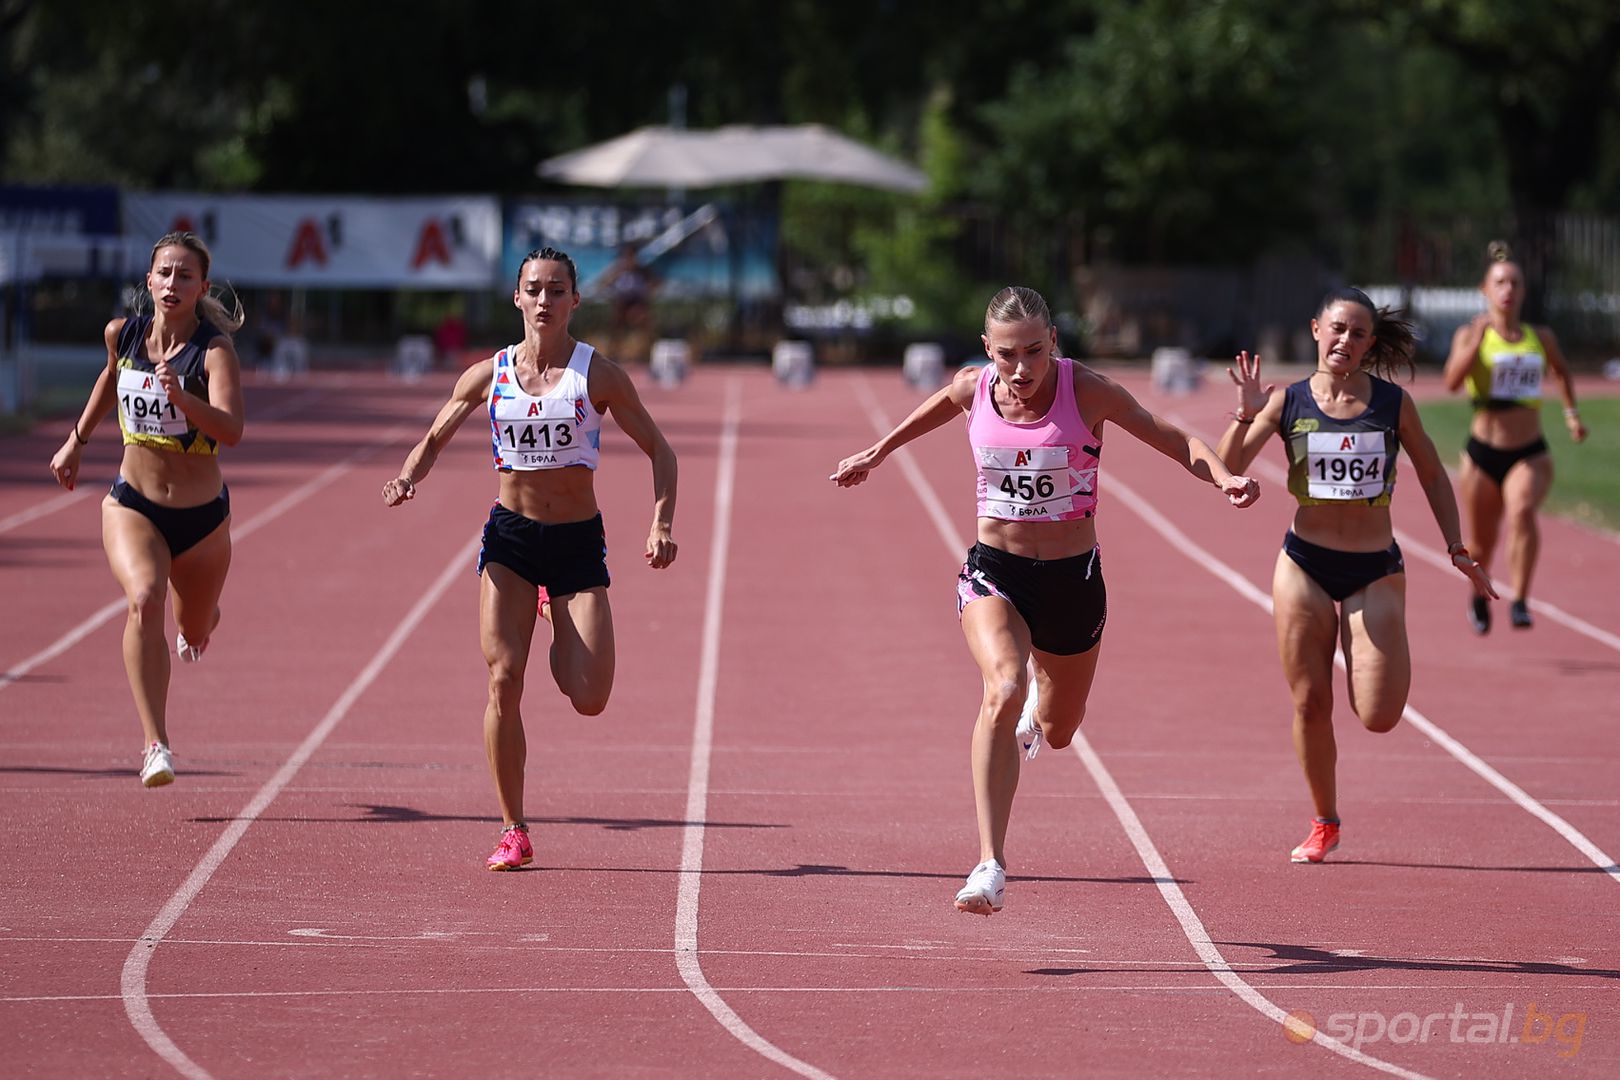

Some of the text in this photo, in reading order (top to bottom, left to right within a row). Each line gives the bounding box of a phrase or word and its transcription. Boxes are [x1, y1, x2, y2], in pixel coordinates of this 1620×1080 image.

[284, 212, 343, 271] A1
[409, 212, 467, 272] A1
[142, 375, 154, 390] A1
[122, 394, 177, 420] 1941
[527, 400, 543, 417] A1
[504, 423, 573, 449] 1413
[1340, 435, 1355, 451] A1
[531, 454, 557, 463] БФЛА
[1014, 449, 1032, 467] A1
[1315, 457, 1379, 482] 1964
[1000, 474, 1055, 501] 456
[1018, 506, 1048, 517] БФЛА
